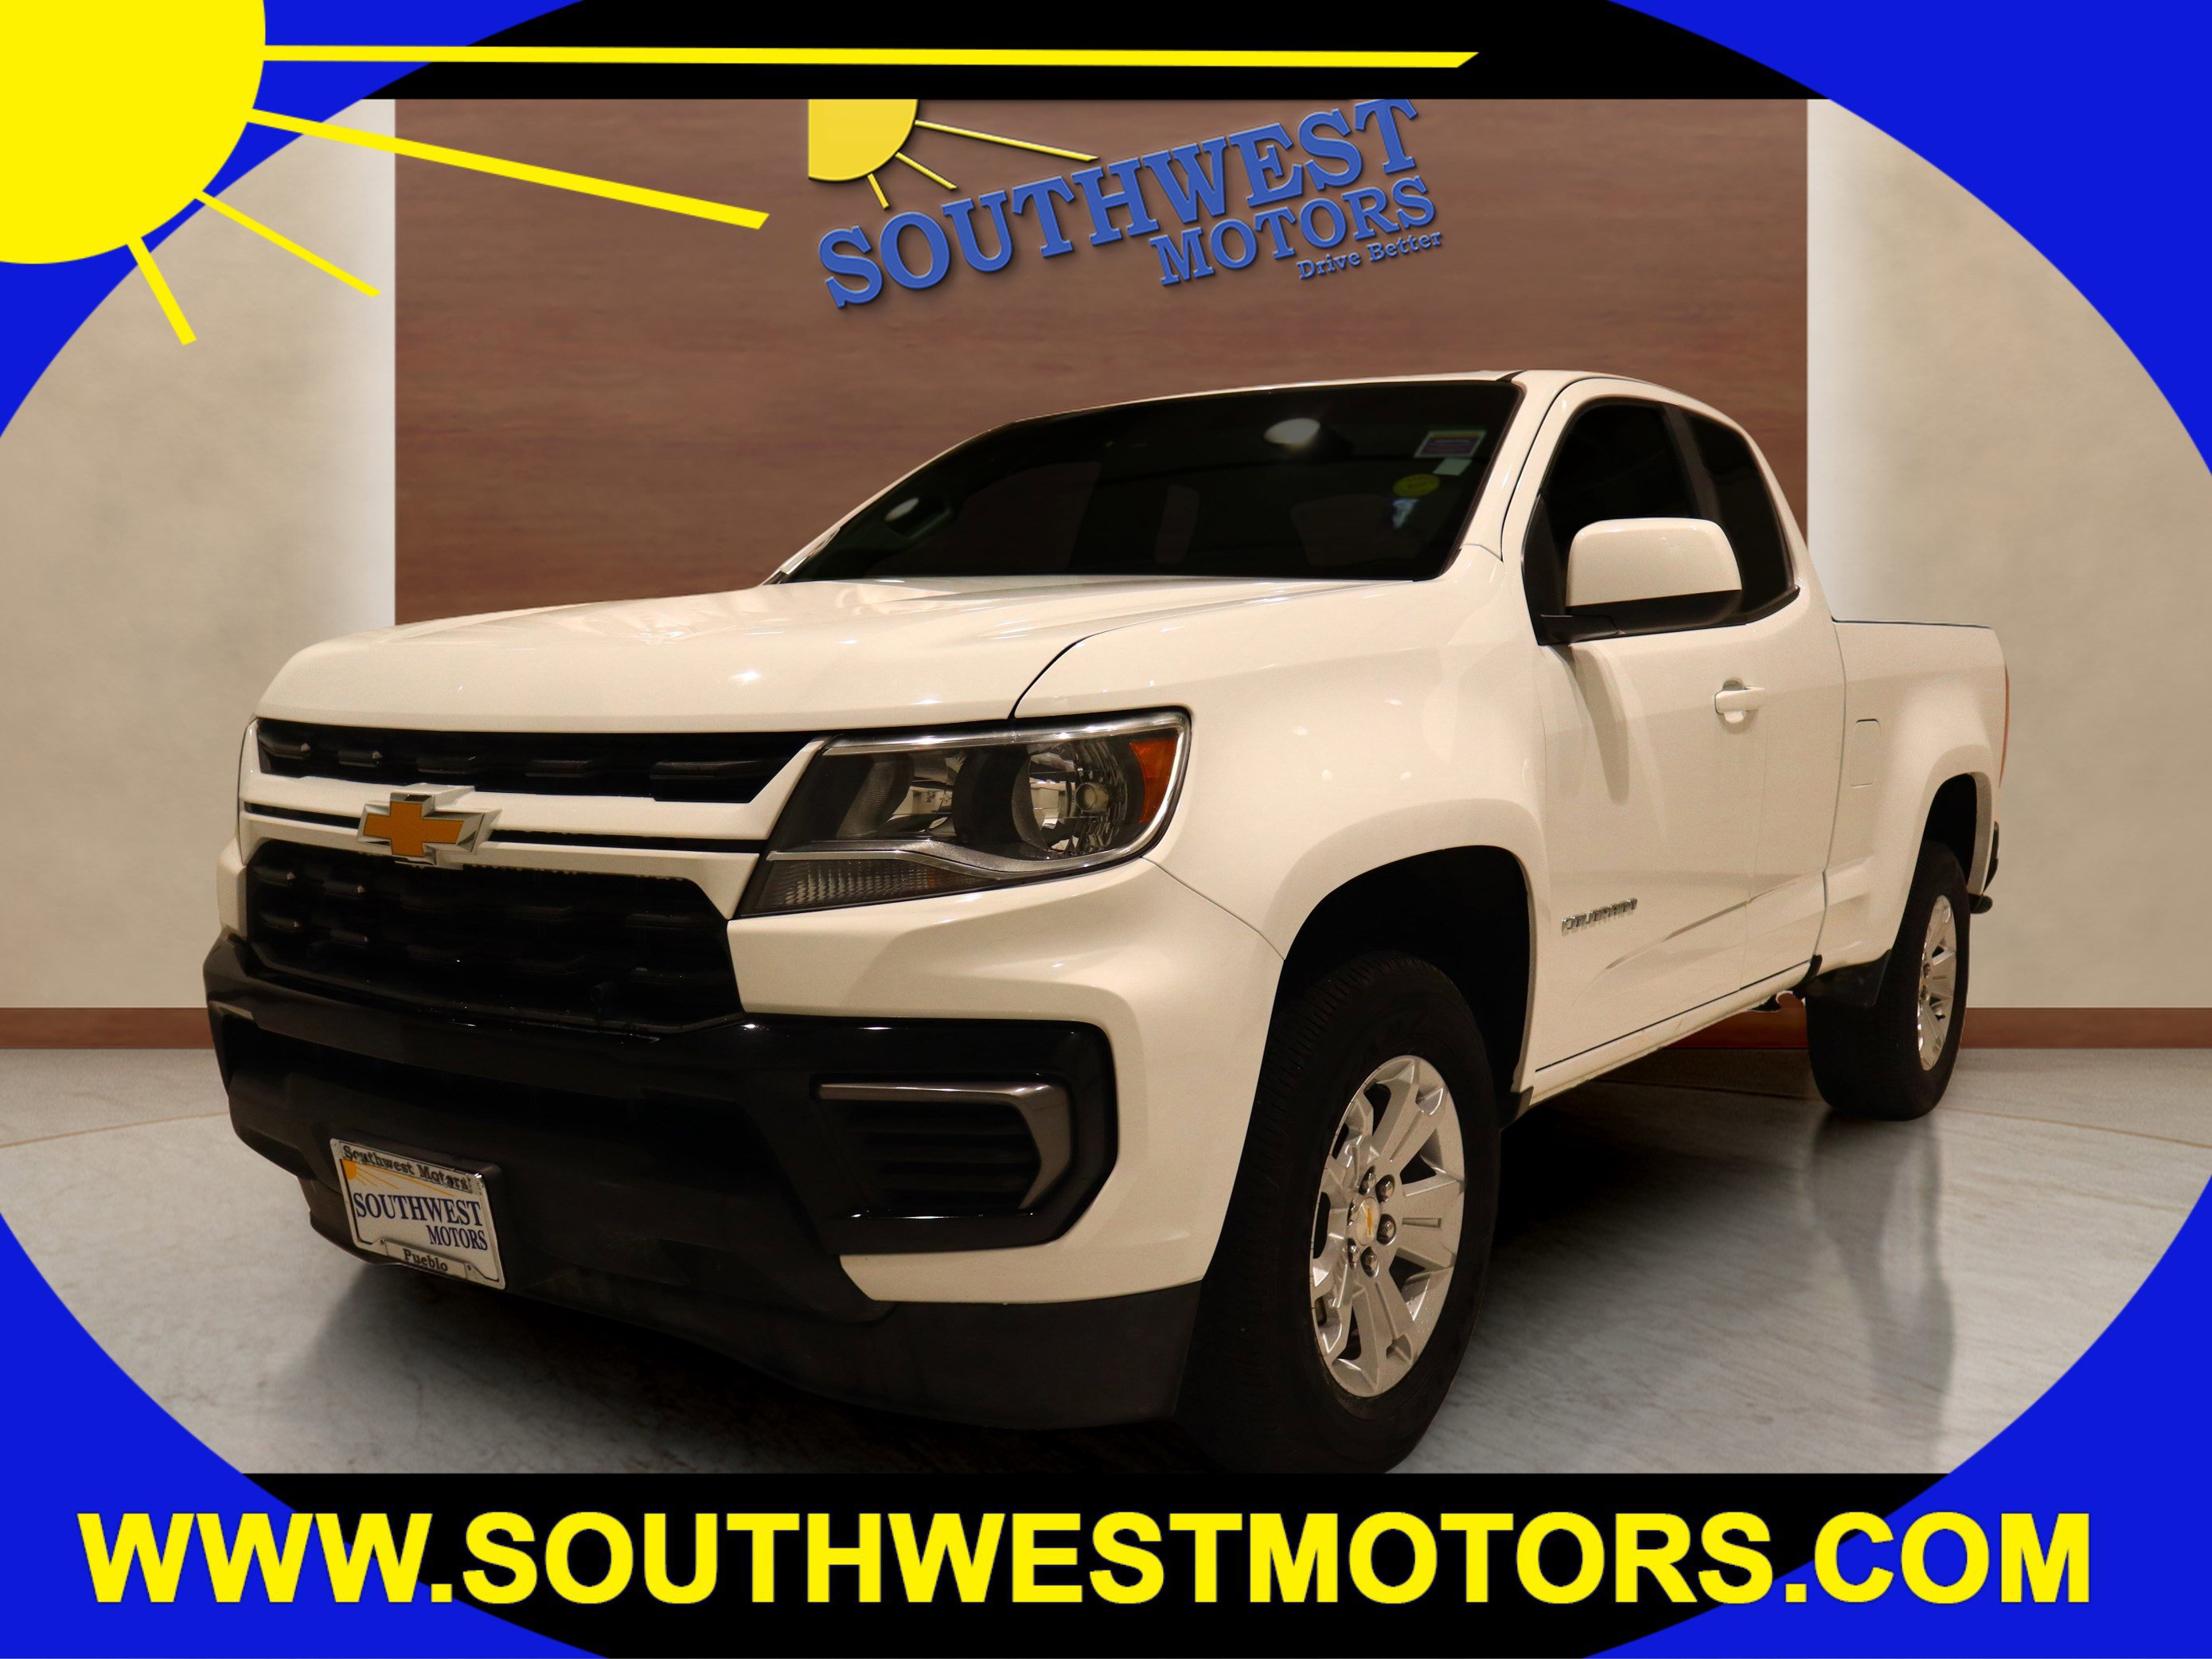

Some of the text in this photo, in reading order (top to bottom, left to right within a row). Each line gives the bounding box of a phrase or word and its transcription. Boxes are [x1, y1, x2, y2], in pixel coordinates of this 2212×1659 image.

[818, 99, 1418, 308] SOUTHWEST
[1150, 176, 1436, 286] MOTORS
[1297, 232, 1442, 279] Drive Better
[343, 1145, 414, 1175] Southwest
[353, 1193, 483, 1227] SOUTHWEST
[426, 1224, 488, 1251] MOTORS
[402, 1247, 448, 1273] Pueblo
